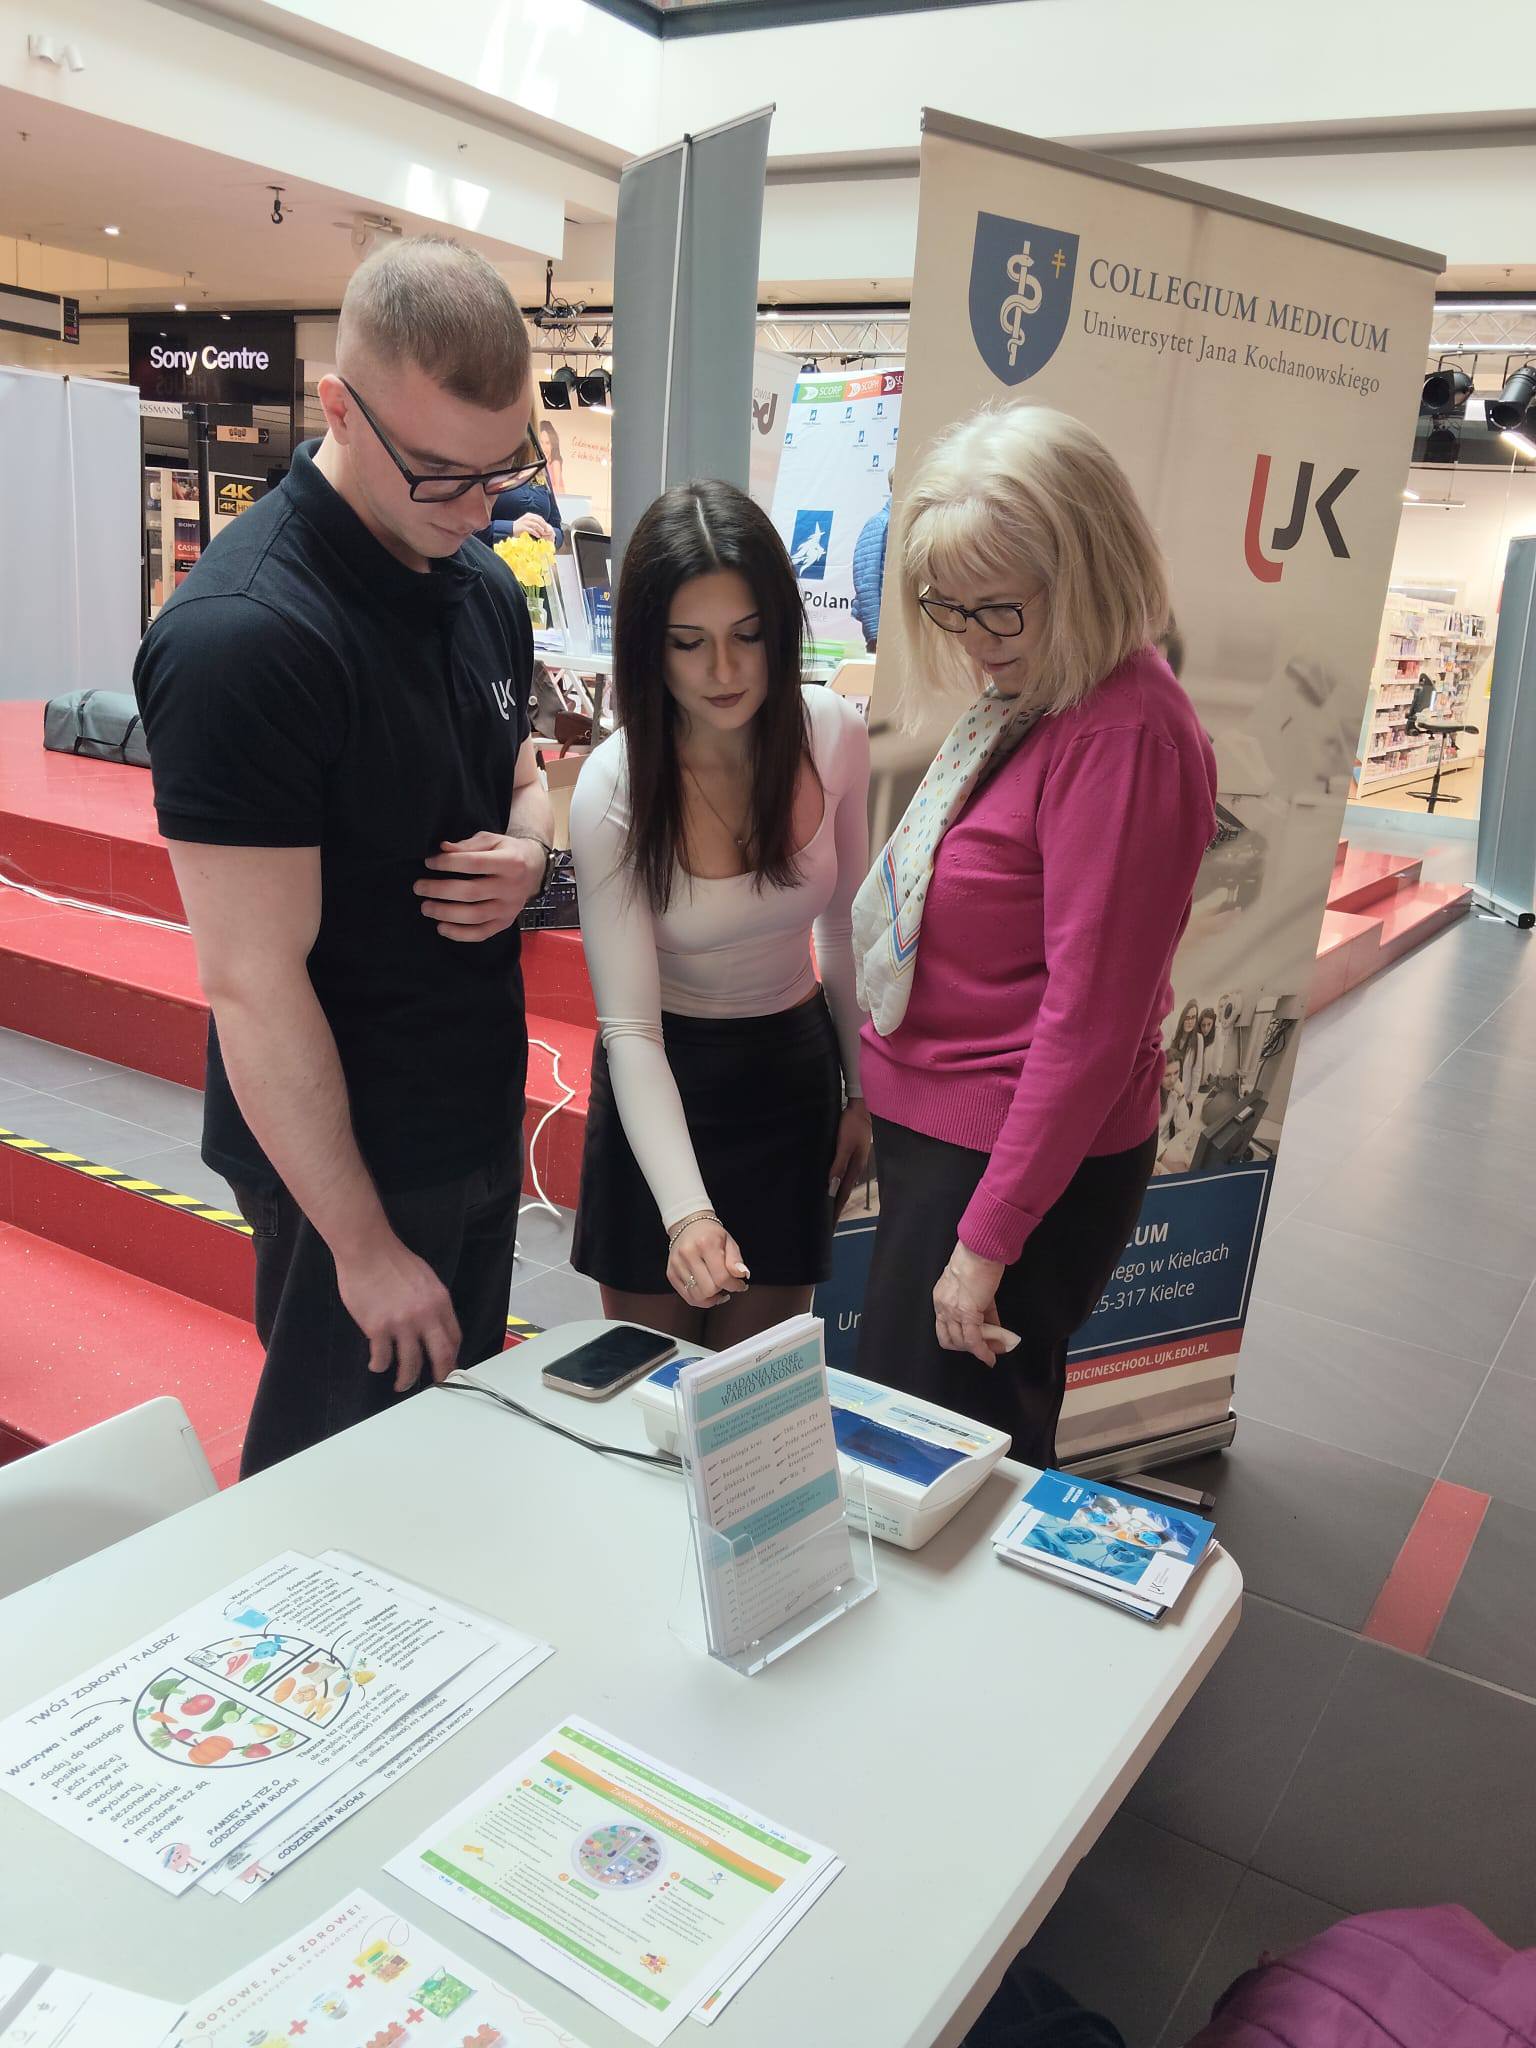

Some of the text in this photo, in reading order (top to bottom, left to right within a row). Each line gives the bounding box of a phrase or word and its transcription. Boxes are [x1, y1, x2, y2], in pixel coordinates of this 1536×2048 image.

[1089, 258, 1391, 353] COLLEGIUM MEDICUM
[150, 345, 269, 375] Sony Centre
[1083, 309, 1380, 397] Uniwersytet Jana Kochanowskiego
[818, 385, 843, 396] SCORP
[220, 483, 254, 500] 4K
[220, 502, 236, 512] 4K
[1245, 453, 1360, 583] UJK
[803, 591, 855, 609] Polan
[491, 679, 516, 720] UJK
[1125, 1222, 1169, 1248] UM
[1150, 1260, 1164, 1273] w
[1168, 1243, 1229, 1271] Kielcach
[1150, 1281, 1195, 1304] Kielce
[1066, 1342, 1209, 1384] EDICINESCHOOL.UJK.EDU.PL
[720, 1383, 756, 1406] WARTO
[725, 1367, 768, 1395] BADANIA
[26, 1633, 179, 1724] TWÓJ ZDROWY TALERZ
[6, 1742, 60, 1776] Warzywa
[70, 1715, 102, 1736] owoce
[40, 1723, 124, 1780] dodaj do każdego
[51, 1763, 87, 1788] posiłku
[63, 1753, 122, 1795] jedz więcej
[74, 1774, 112, 1800] warzyw
[86, 1780, 123, 1807] owoców
[98, 1782, 144, 1814] wybieraj
[110, 1788, 157, 1822] sezonowo
[122, 1785, 181, 1829] różnorodnie
[207, 1799, 252, 1835] PAMIĘTAJ
[252, 1786, 272, 1799] TEŻ
[210, 1802, 268, 1848] CODZIENNYM
[147, 1815, 184, 1843] zdrowe
[278, 1814, 336, 1860] CODZIENNYM
[270, 1953, 295, 1976] ALE
[299, 1903, 362, 1954] ZDROWE!
